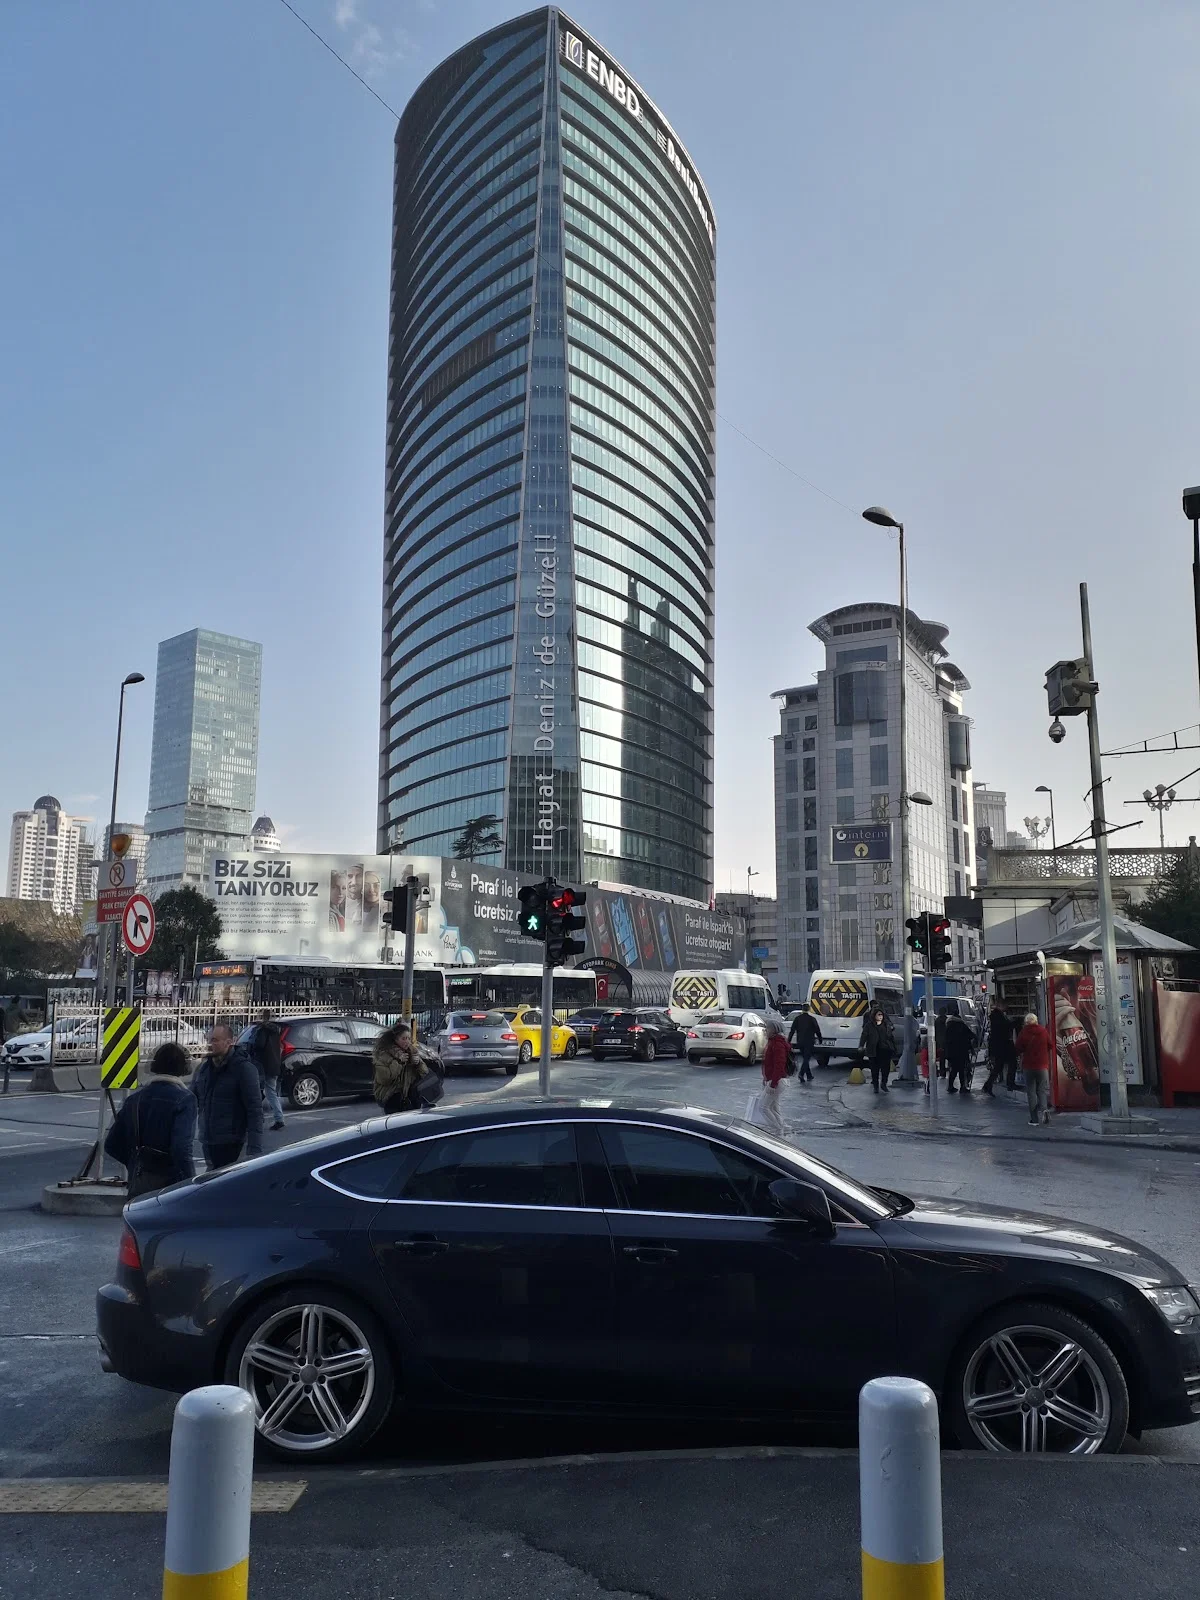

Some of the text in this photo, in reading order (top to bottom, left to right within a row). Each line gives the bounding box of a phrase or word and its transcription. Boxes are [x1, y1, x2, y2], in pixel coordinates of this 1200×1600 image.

[587, 49, 640, 118] ENBD
[532, 534, 560, 850] Hayat Deniz'de Güzel!
[214, 881, 319, 897] TANIYORUZ
[470, 873, 499, 895] Paraf
[501, 879, 513, 898] ile
[473, 900, 514, 921] ücretsiz
[685, 913, 701, 928] Paraf
[685, 932, 708, 948] ücretsiz
[841, 992, 861, 1000] TAŞITI
